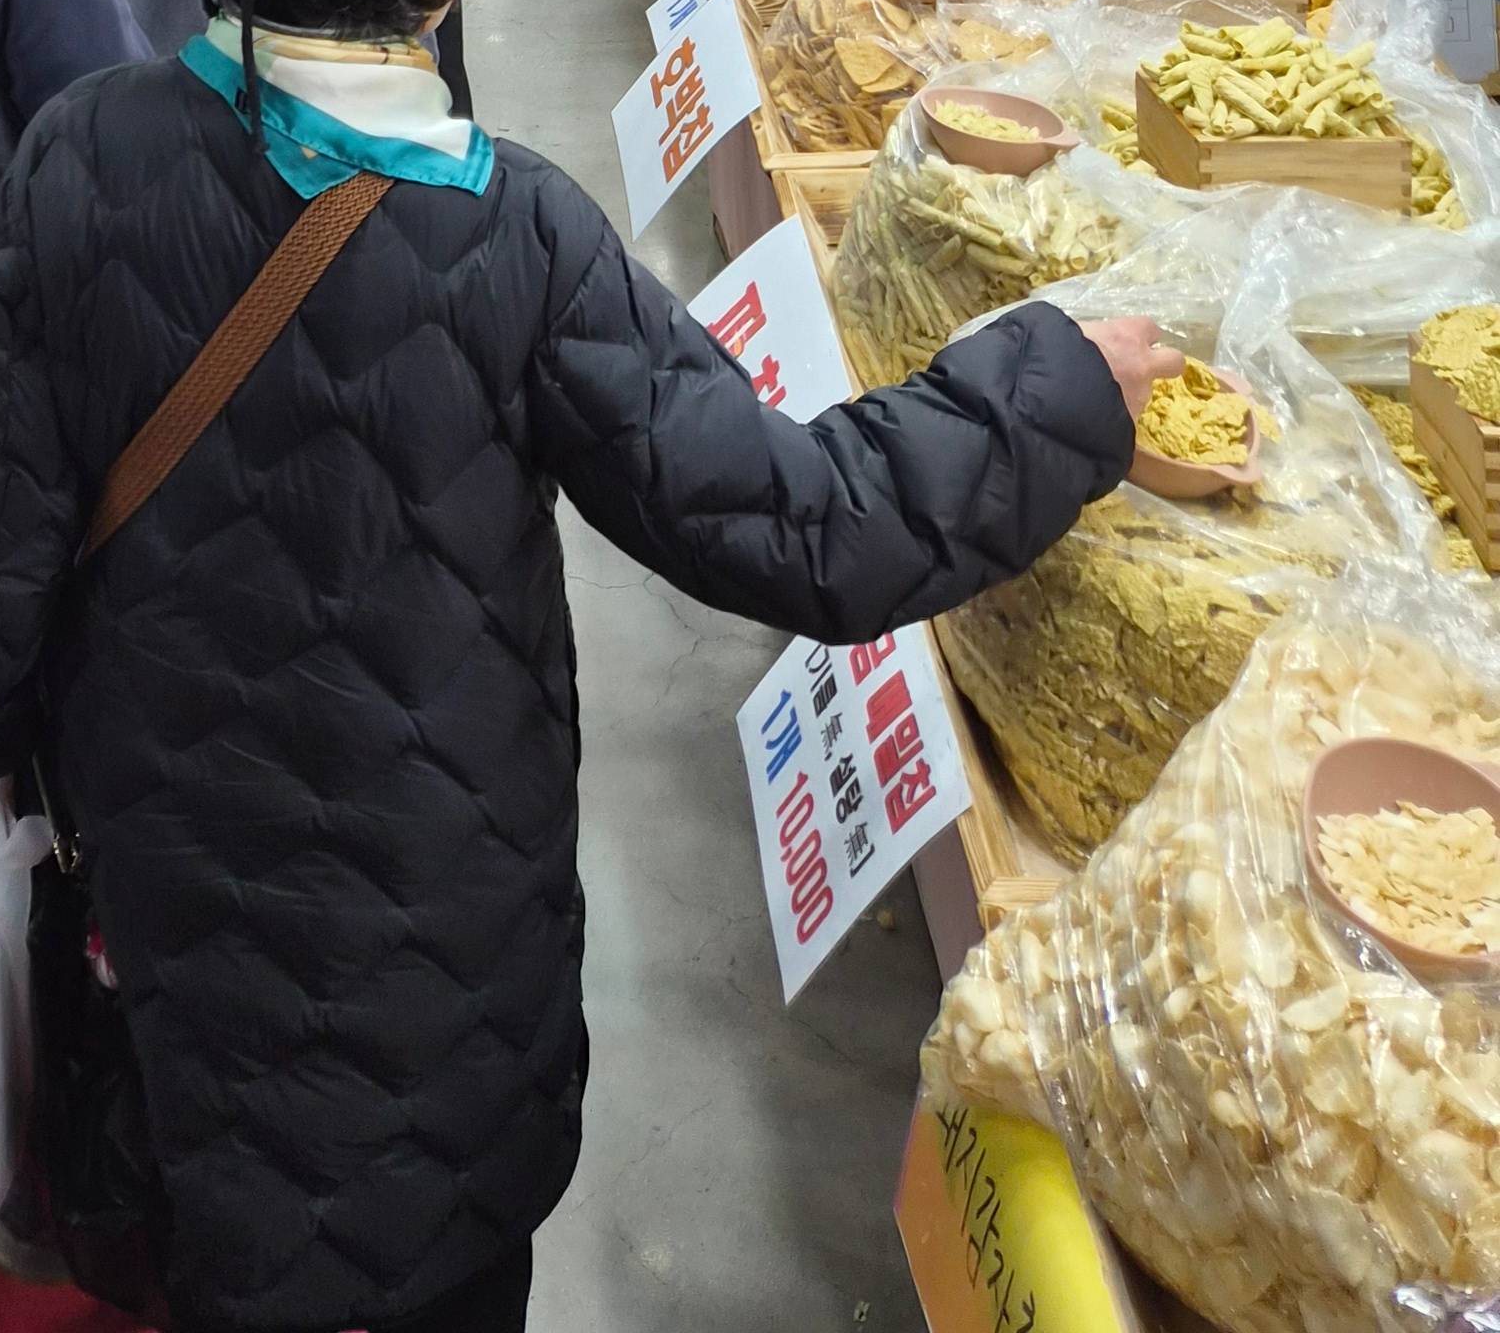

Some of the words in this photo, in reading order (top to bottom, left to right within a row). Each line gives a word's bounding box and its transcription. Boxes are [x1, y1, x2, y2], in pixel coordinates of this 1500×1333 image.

[651, 36, 714, 184] 호박칩
[760, 687, 803, 785] 1개
[828, 752, 864, 825] 설탕
[775, 771, 834, 946] 10,000
